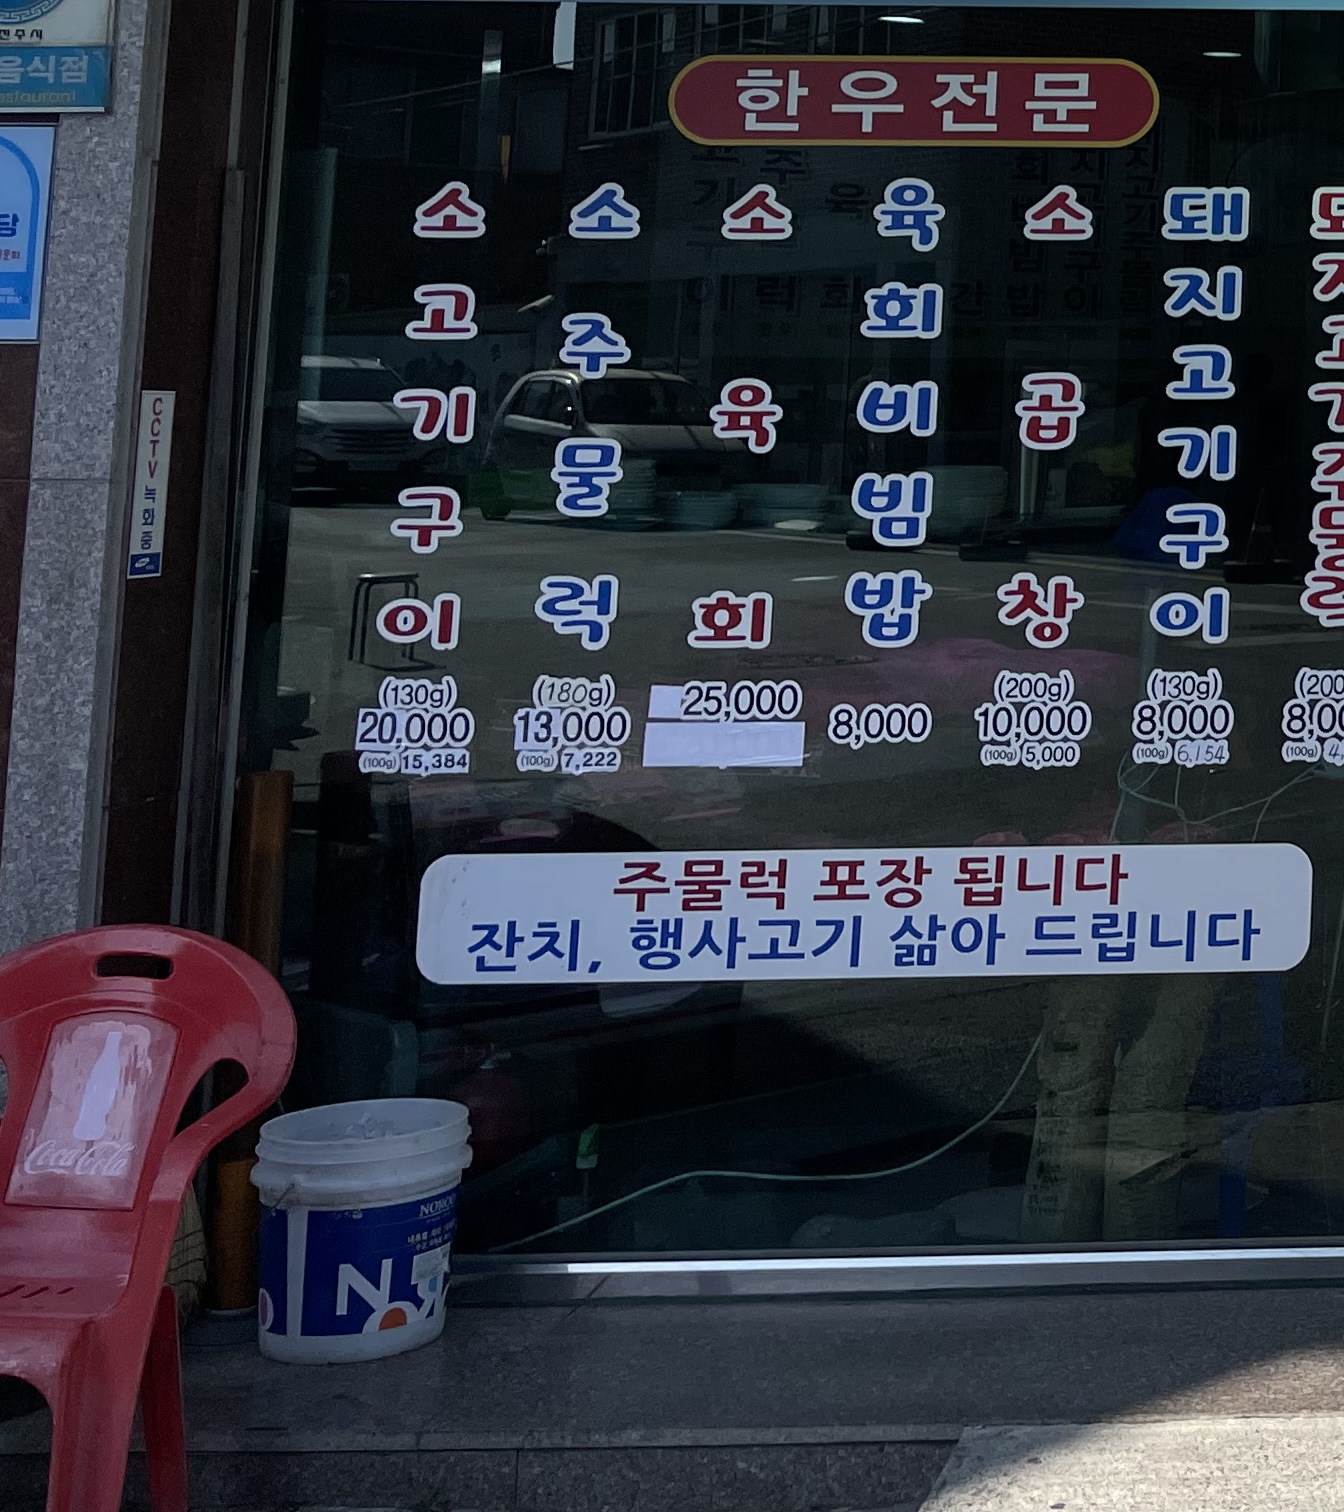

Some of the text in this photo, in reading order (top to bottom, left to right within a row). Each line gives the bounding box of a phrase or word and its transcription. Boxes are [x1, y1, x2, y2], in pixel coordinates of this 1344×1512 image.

[733, 67, 1099, 135] 한우전문
[147, 396, 164, 480] CCTV
[380, 676, 456, 709] (130g)
[533, 676, 614, 708] (180g)
[680, 683, 803, 720] 25,000
[996, 670, 1073, 700] (200g)
[1149, 669, 1220, 699] (130g)
[358, 709, 473, 748] 20,000
[514, 709, 628, 749] 13,000
[828, 705, 932, 746] 8,000
[976, 702, 1091, 740] 10,000
[1134, 700, 1233, 739] 8,000
[360, 752, 470, 772] (100g) 15,384
[519, 750, 620, 772] (100g) 7,222
[982, 744, 1078, 767] (100g) 5,000
[1135, 744, 1170, 762] (100g)
[1284, 742, 1321, 761] (100g)
[613, 854, 1129, 913] 주물럭 포장 됩니다
[466, 909, 1262, 976] 잔치, 행사고기 삶아 드립니다
